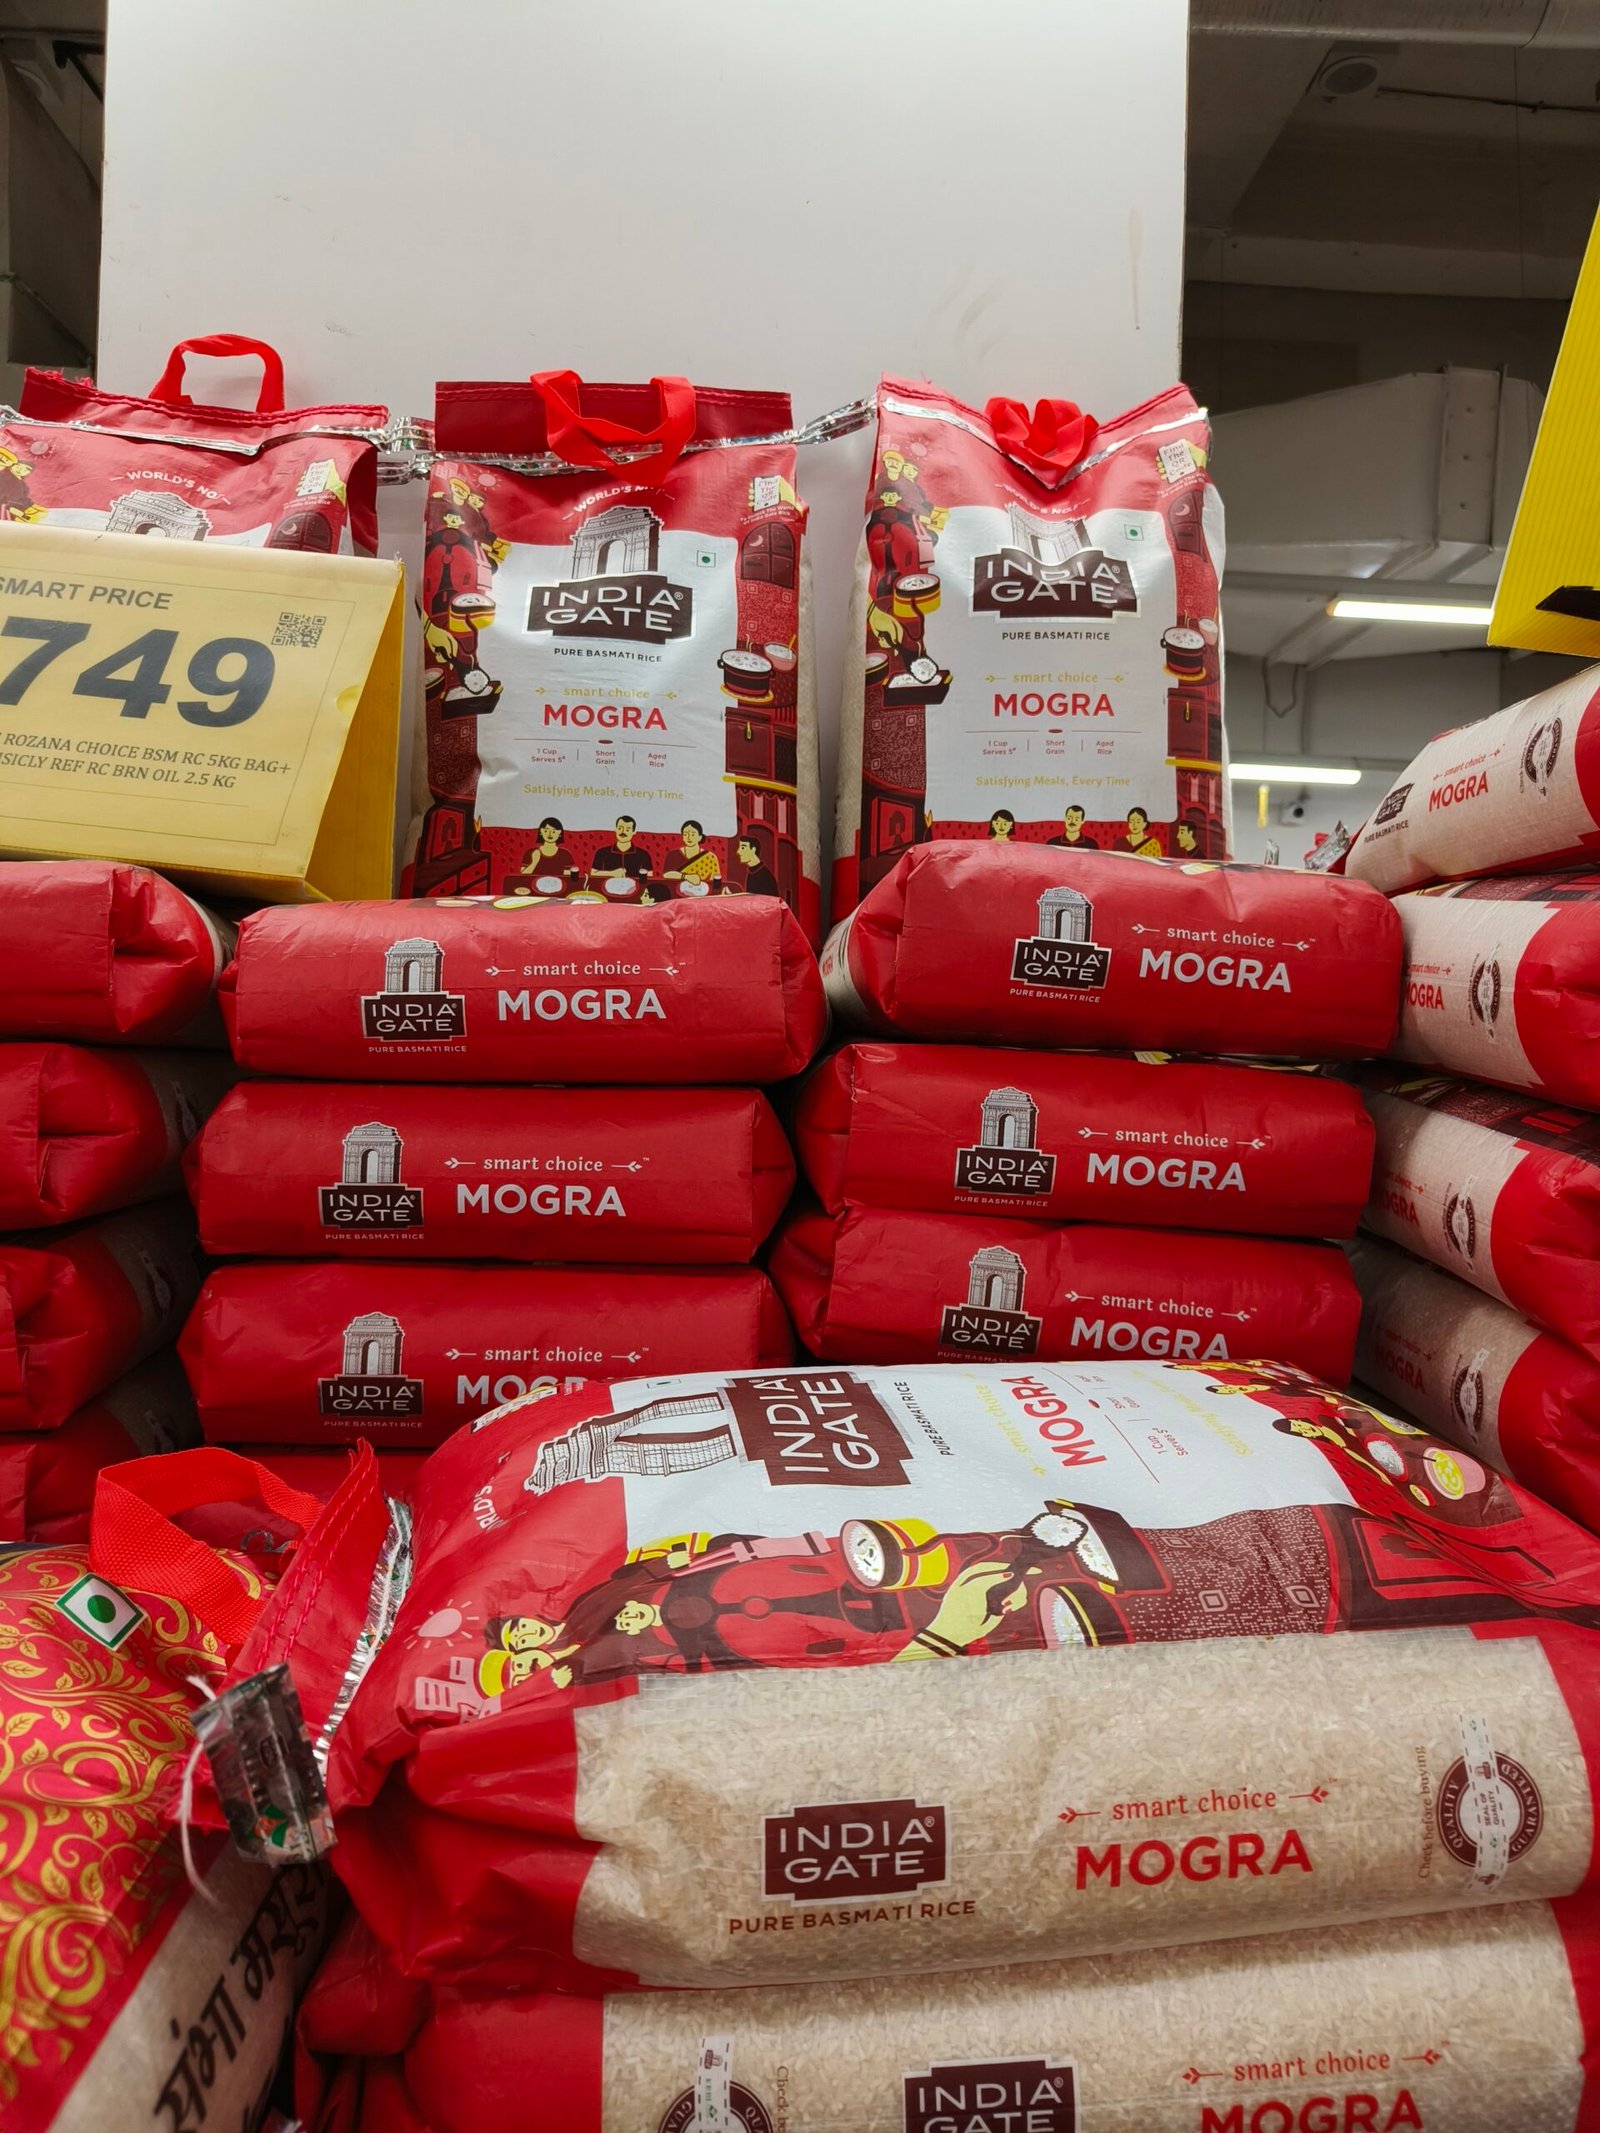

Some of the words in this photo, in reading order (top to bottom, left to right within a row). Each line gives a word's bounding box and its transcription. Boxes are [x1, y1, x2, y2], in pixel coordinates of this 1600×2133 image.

[126, 470, 195, 488] WORLD'S
[574, 485, 632, 514] WORLD'S
[987, 560, 1120, 583] INDIA
[89, 586, 173, 610] PRICE
[543, 586, 682, 611] INDIA
[990, 580, 1118, 604] GATE
[545, 607, 672, 632] GATE
[1002, 632, 1031, 640] PURE
[1034, 632, 1083, 640] BASMATI
[1085, 632, 1110, 640] RICE
[554, 648, 583, 658] PURE
[586, 649, 635, 662] BASMATI
[638, 654, 662, 664] RICE
[0, 615, 275, 727] 749
[1013, 673, 1053, 683] smart
[1058, 672, 1098, 683] choice
[563, 687, 604, 698] smart
[608, 688, 650, 699] choice
[994, 692, 1115, 717] MOGRA
[543, 703, 668, 731] MOGRA
[3, 733, 71, 752] ROZANA
[76, 740, 139, 759] CHOICE
[142, 747, 179, 763] BSM
[182, 751, 205, 766] RC
[207, 754, 241, 769] 5KG
[243, 758, 291, 774] BAG+
[542, 748, 557, 756] Cup
[648, 752, 667, 760] Aged
[993, 740, 1008, 748] Cup
[0, 752, 49, 768] SICLY
[50, 756, 84, 772] REF
[86, 761, 110, 776] RC
[112, 764, 150, 780] BRN
[152, 768, 180, 783] OIL
[184, 772, 209, 786] 2.5
[212, 774, 236, 789] KG
[976, 776, 1031, 788] Satisfying
[1034, 776, 1069, 787] Meals,
[1072, 776, 1102, 788] Every
[1106, 776, 1131, 786] Time
[523, 784, 580, 798] Satisfying
[583, 786, 619, 798] Meals,
[623, 788, 654, 800] Every
[658, 790, 684, 800] Time
[1429, 771, 1488, 812] MOGRA
[1396, 819, 1409, 830] RICE
[1167, 927, 1217, 943] smart
[1223, 931, 1275, 948] choice
[523, 961, 578, 977] smart
[584, 960, 641, 976] choice
[1024, 947, 1103, 967] INDIA
[1024, 963, 1095, 982] GATE
[1139, 948, 1292, 993] MOGRA
[498, 988, 667, 1021] MOGRA
[1010, 988, 1034, 997] PURE
[1036, 991, 1078, 1001] BASMATI
[1079, 995, 1100, 1003] RICE
[372, 1003, 456, 1018] INDIA
[376, 1019, 453, 1033] GATE
[1116, 1130, 1167, 1144] smart
[1173, 1132, 1229, 1148] choice
[483, 1156, 539, 1171] smart
[545, 1155, 603, 1172] choice
[966, 1155, 1048, 1173] INDIA
[1086, 1153, 1246, 1192] MOGRA
[967, 1171, 1041, 1188] GATE
[329, 1193, 415, 1208] INDIA
[456, 1183, 627, 1217] MOGRA
[981, 1197, 1025, 1206] BASMATI
[333, 1209, 411, 1222] GATE
[1102, 1293, 1153, 1312] smart
[1160, 1298, 1214, 1319] choice
[952, 1314, 1033, 1336] INDIA
[952, 1331, 1024, 1349] GATE
[1070, 1317, 1230, 1360] MOGRA
[484, 1348, 539, 1362] smart
[545, 1347, 603, 1363] choice
[329, 1384, 415, 1398] INDIA
[894, 1381, 915, 1401] RICE
[333, 1399, 411, 1412] GATE
[753, 1377, 830, 1473] INDIA
[800, 1378, 880, 1470] GATE
[905, 1402, 938, 1434] BASMATI
[1001, 1376, 1107, 1467] MOGRA
[928, 1435, 955, 1456] PURE
[1415, 1745, 1431, 1794] buying
[1112, 1795, 1189, 1820] smart
[1198, 1787, 1277, 1813] choice
[1443, 1779, 1464, 1849] QUALITY
[1421, 1798, 1435, 1835] before
[780, 1816, 934, 1853] INDIA
[784, 1850, 925, 1883] GATE
[1076, 1829, 1313, 1890] MOGRA
[1418, 1838, 1431, 1879] Check
[729, 1915, 795, 1934] PURE
[802, 1904, 912, 1929] BASMATI
[921, 1900, 976, 1918] RICE
[1234, 2056, 1307, 2082] smart
[1315, 2048, 1390, 2076] choice
[777, 2066, 790, 2112] Check
[919, 2077, 1064, 2113] INDIA
[924, 2109, 1055, 2133] GATE
[1201, 2089, 1425, 2133] MOGRA
